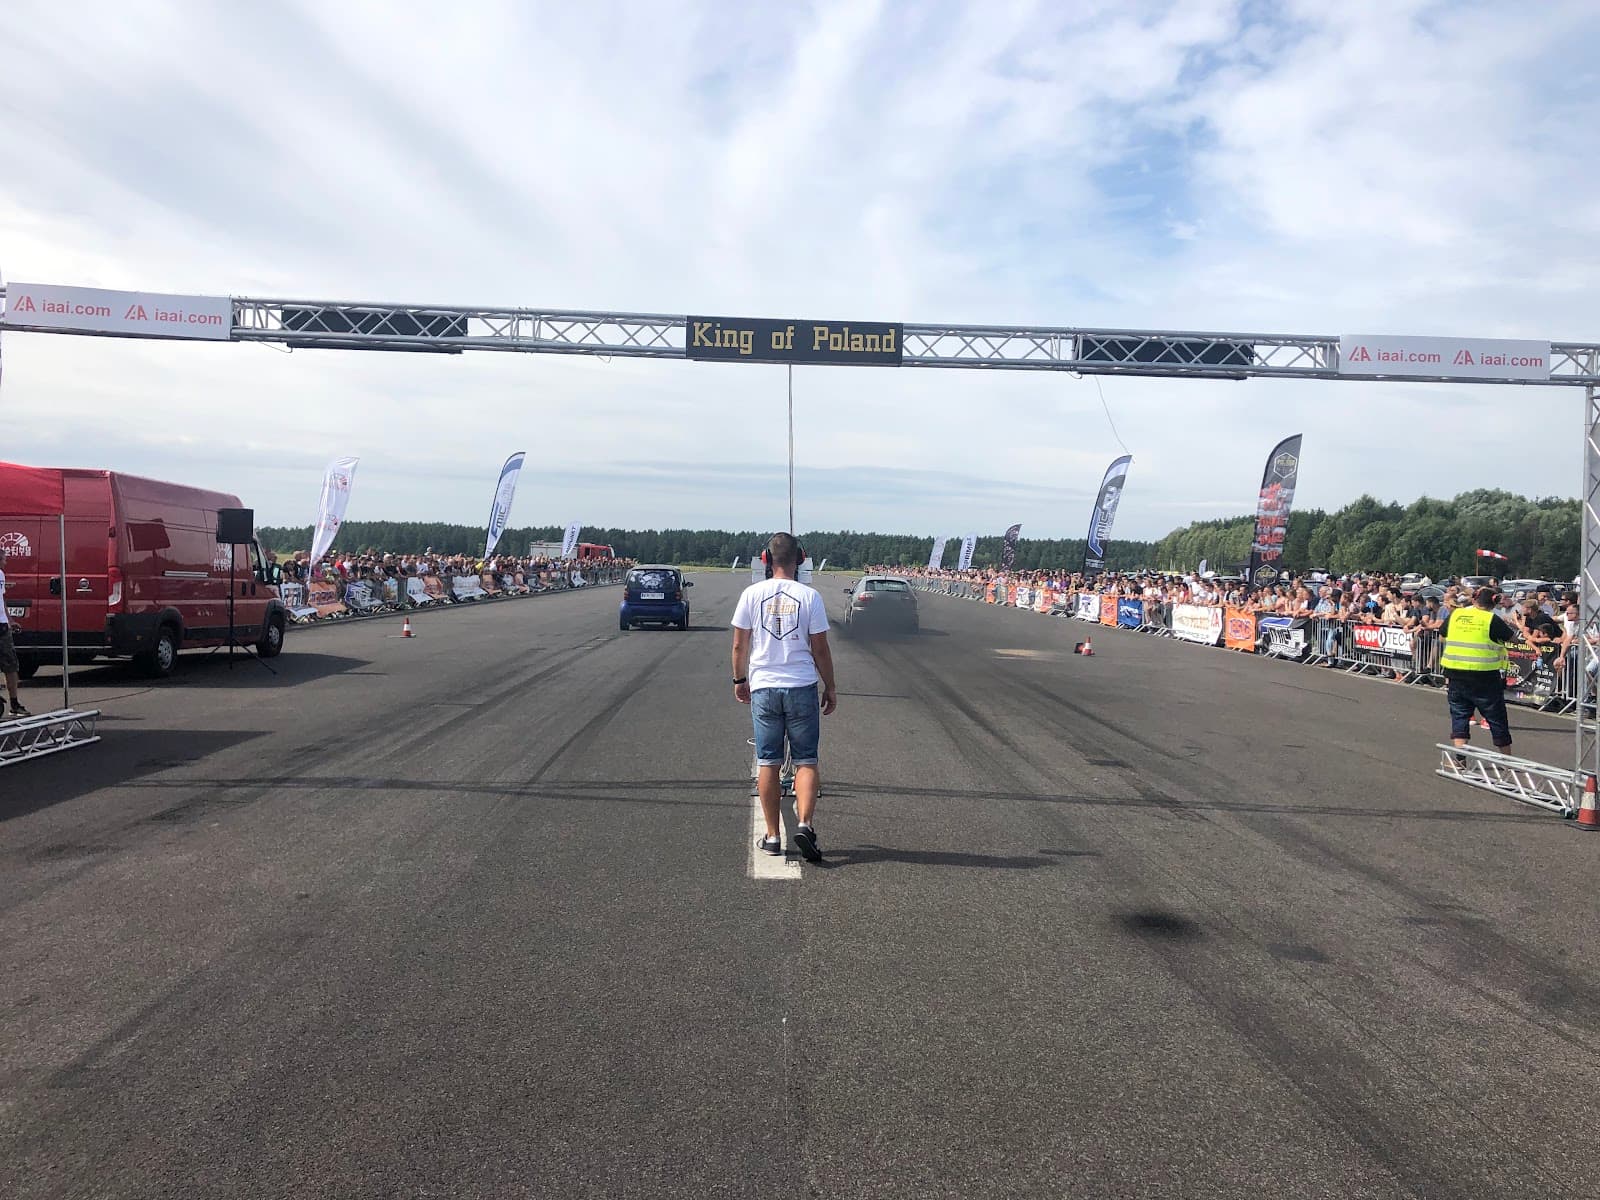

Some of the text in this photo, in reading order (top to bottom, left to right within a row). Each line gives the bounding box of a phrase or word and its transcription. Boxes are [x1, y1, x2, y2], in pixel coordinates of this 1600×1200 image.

[42, 299, 111, 317] iaai.com
[154, 308, 223, 325] iaai.com
[693, 322, 897, 355] King of Poland
[1377, 349, 1441, 364] iaai.com
[1480, 353, 1543, 368] iaai.com
